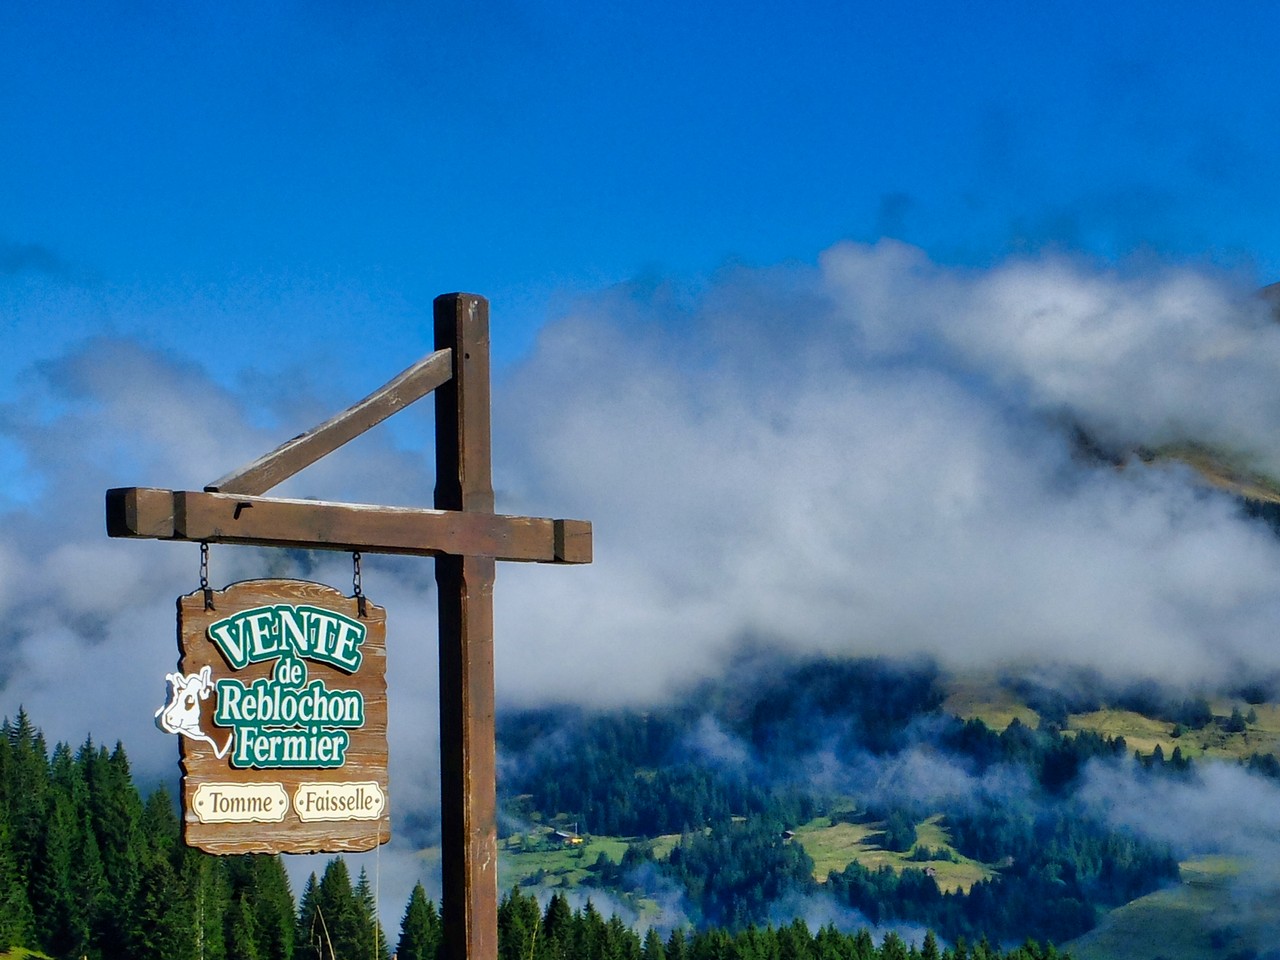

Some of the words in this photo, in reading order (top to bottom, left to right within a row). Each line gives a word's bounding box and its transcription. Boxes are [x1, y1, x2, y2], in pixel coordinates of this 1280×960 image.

[213, 610, 363, 666] VENTE
[278, 657, 301, 684] de
[220, 684, 360, 722] Reblochon
[237, 726, 345, 762] Fermier
[209, 792, 273, 813] Tomme
[305, 788, 373, 812] Faisselle
